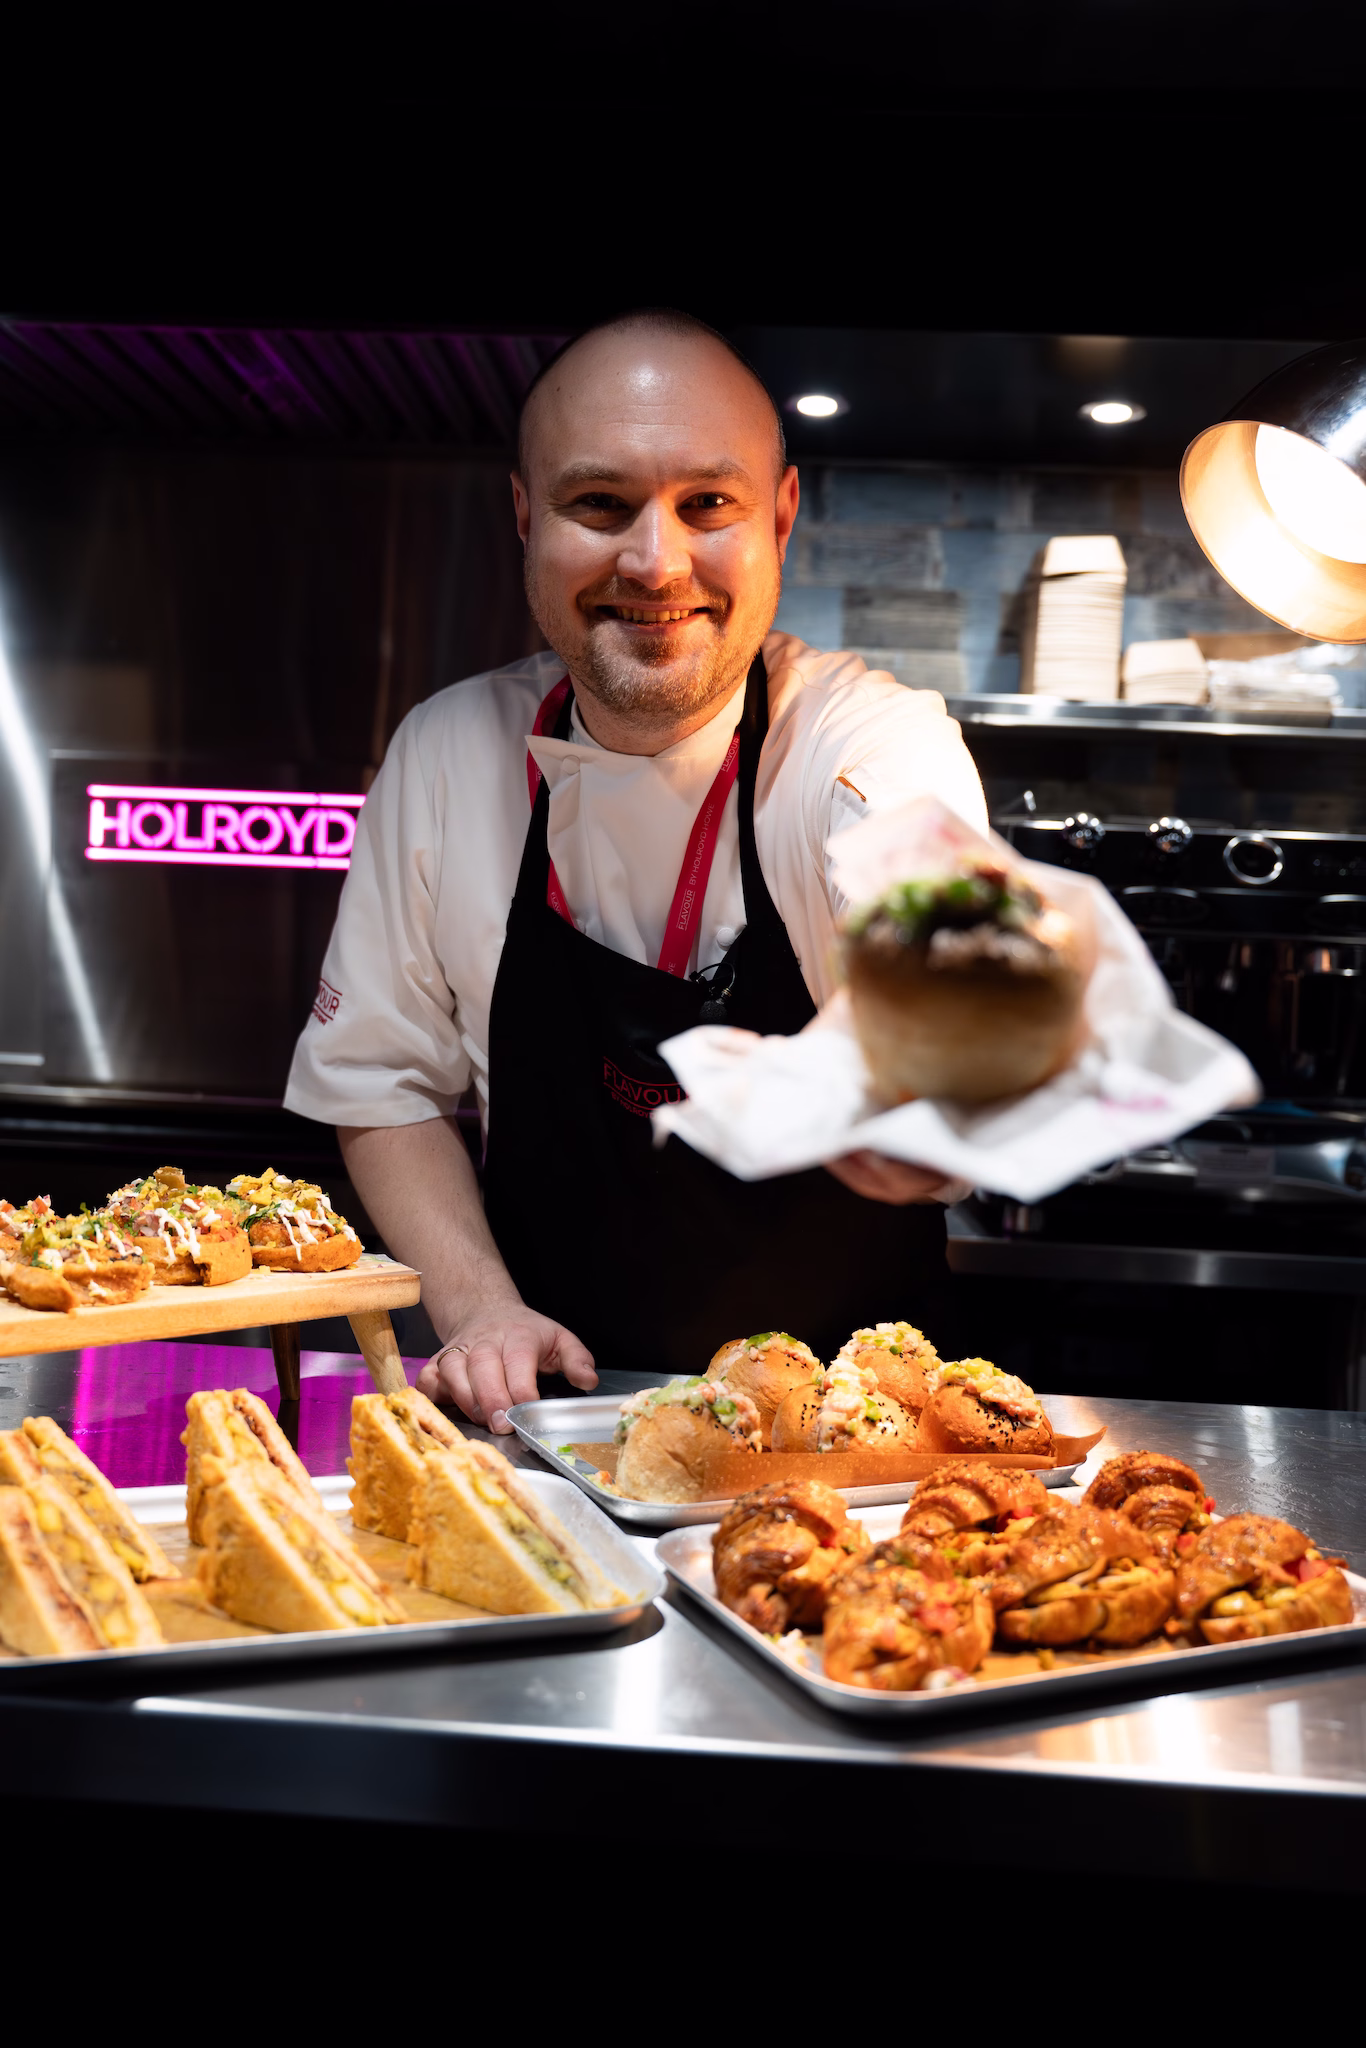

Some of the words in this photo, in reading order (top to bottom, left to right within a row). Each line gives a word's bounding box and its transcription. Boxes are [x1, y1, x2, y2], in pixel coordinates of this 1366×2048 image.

[721, 737, 740, 771] FLAVOUR
[89, 799, 357, 856] HOLROYD
[702, 802, 715, 831] HOWE
[692, 831, 707, 873] HOLROYD
[688, 873, 697, 886] BY
[678, 889, 694, 931] FLAVOUR
[319, 985, 340, 1015] OUR
[603, 1062, 690, 1105] FLAVOU
